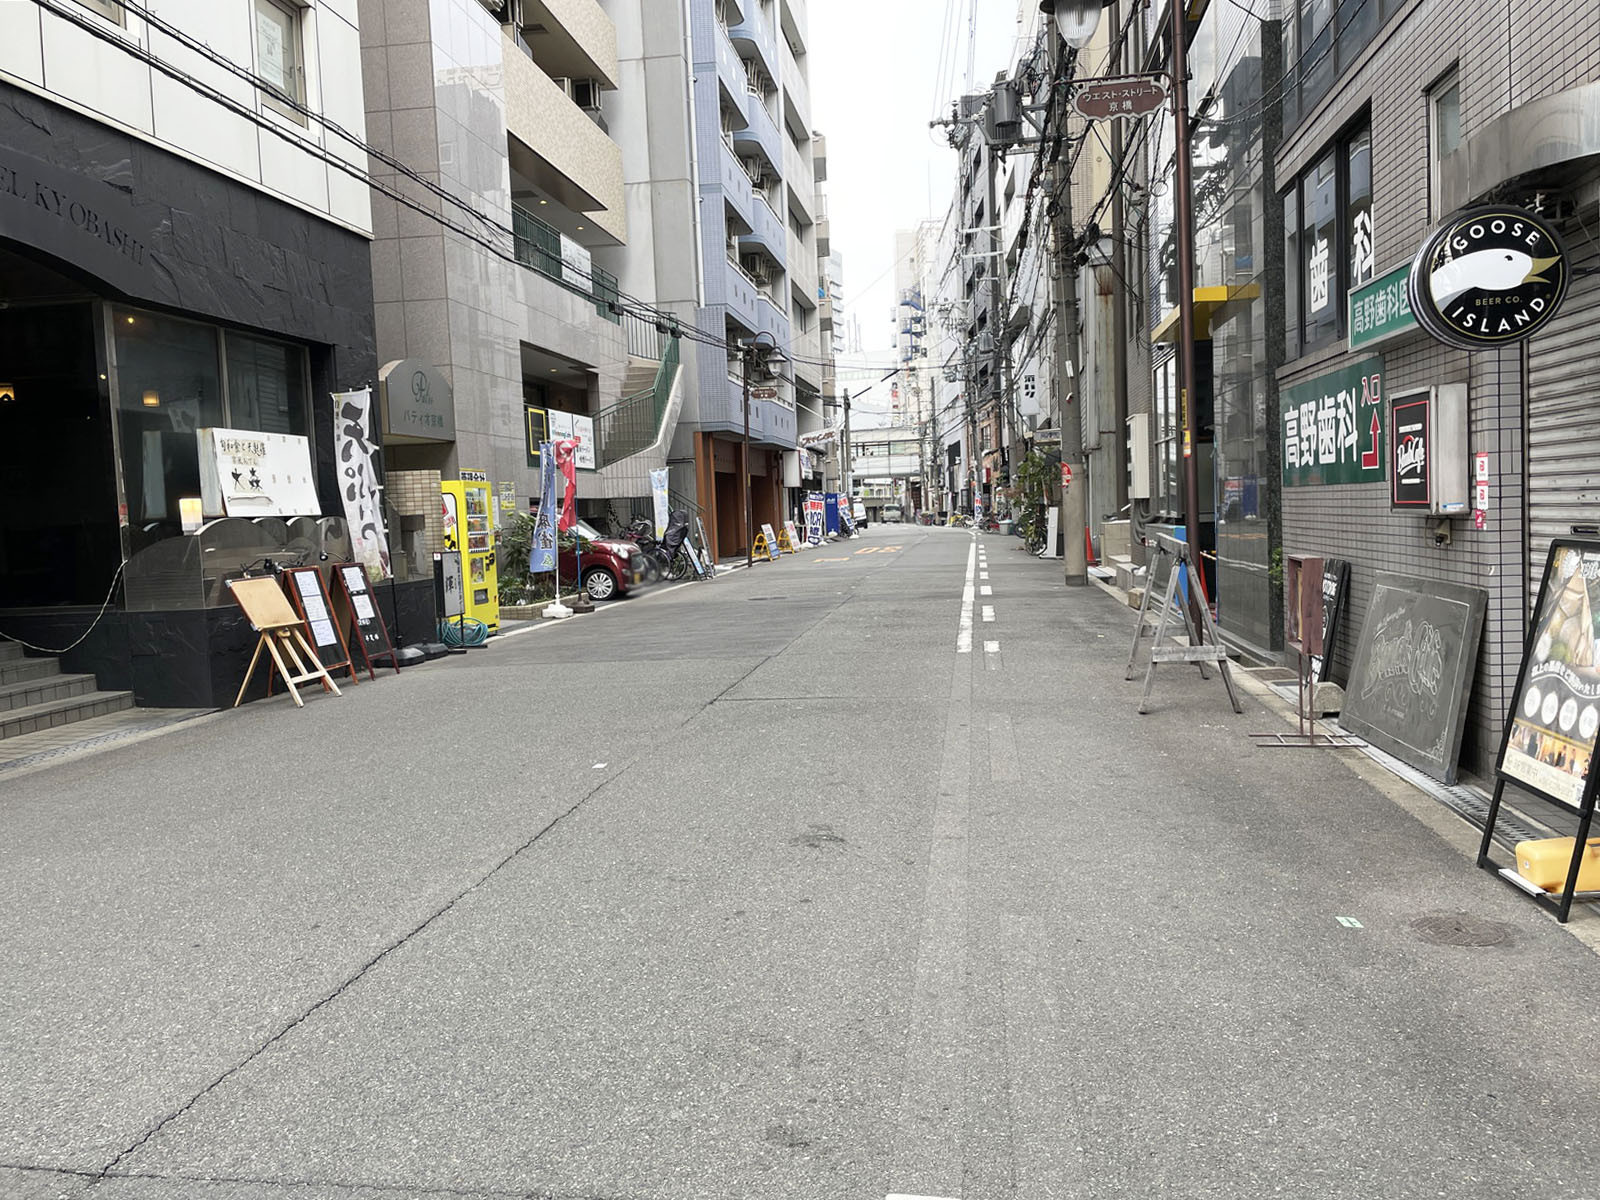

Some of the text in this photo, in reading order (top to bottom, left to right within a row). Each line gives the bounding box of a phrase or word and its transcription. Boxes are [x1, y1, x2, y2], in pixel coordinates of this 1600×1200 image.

[34, 181, 144, 265] KYOBASHI
[1452, 219, 1540, 251] GOOSE
[1353, 277, 1411, 336] 高野歯科医
[1451, 297, 1545, 333] ISLAND
[1475, 295, 1523, 307] BEER CO.
[1360, 373, 1381, 408] 入口
[1284, 387, 1358, 470] 高野歯科
